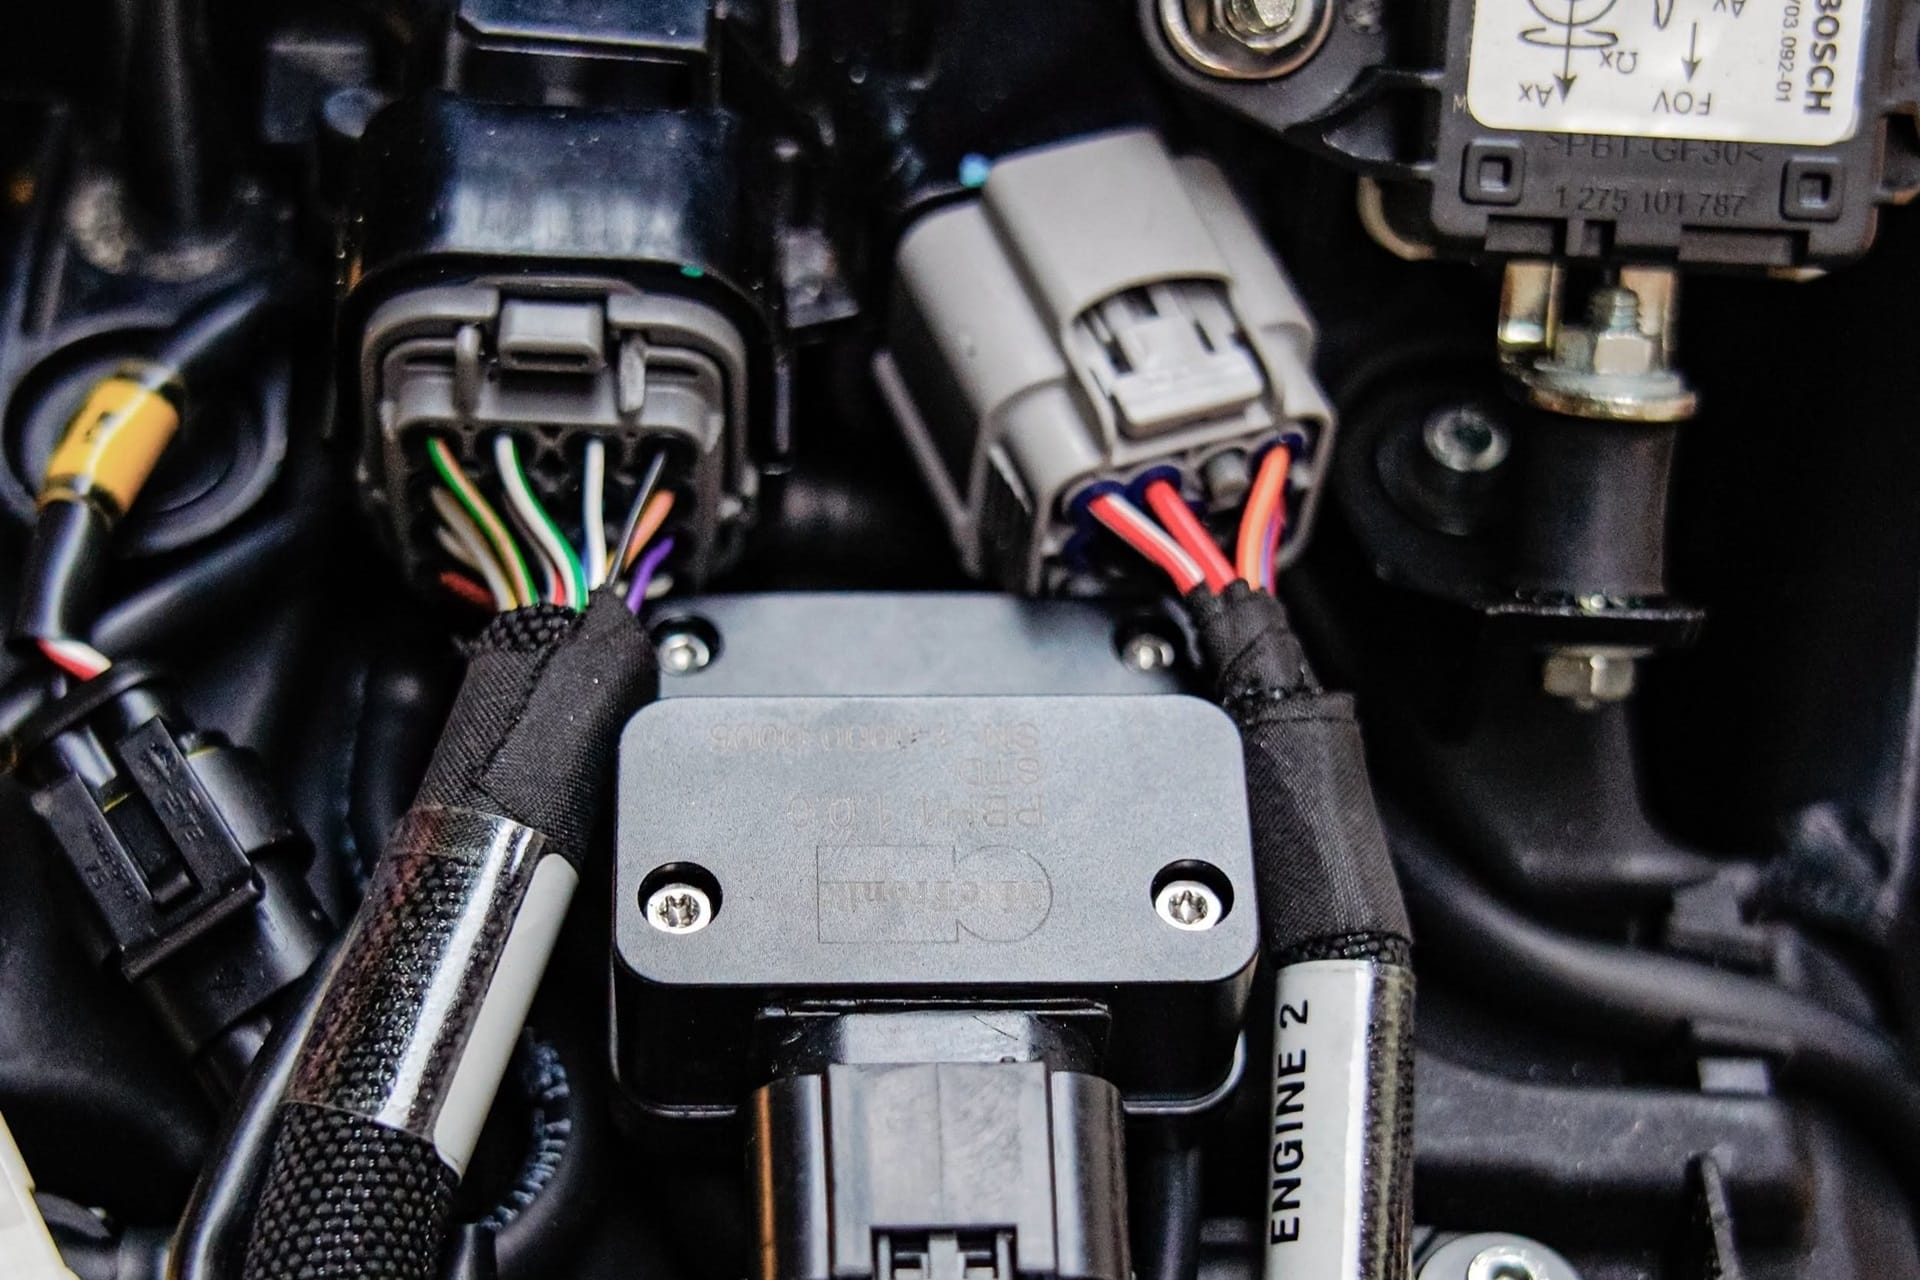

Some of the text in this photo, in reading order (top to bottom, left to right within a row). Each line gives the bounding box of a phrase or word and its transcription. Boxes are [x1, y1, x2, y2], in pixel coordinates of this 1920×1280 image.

[1804, 0, 1841, 114] BOSCH
[1518, 82, 1554, 108] Ax
[1652, 90, 1712, 116] FOV
[1555, 185, 1748, 217] 1 275 101 787
[1270, 1000, 1308, 1245] ENGINE 2
